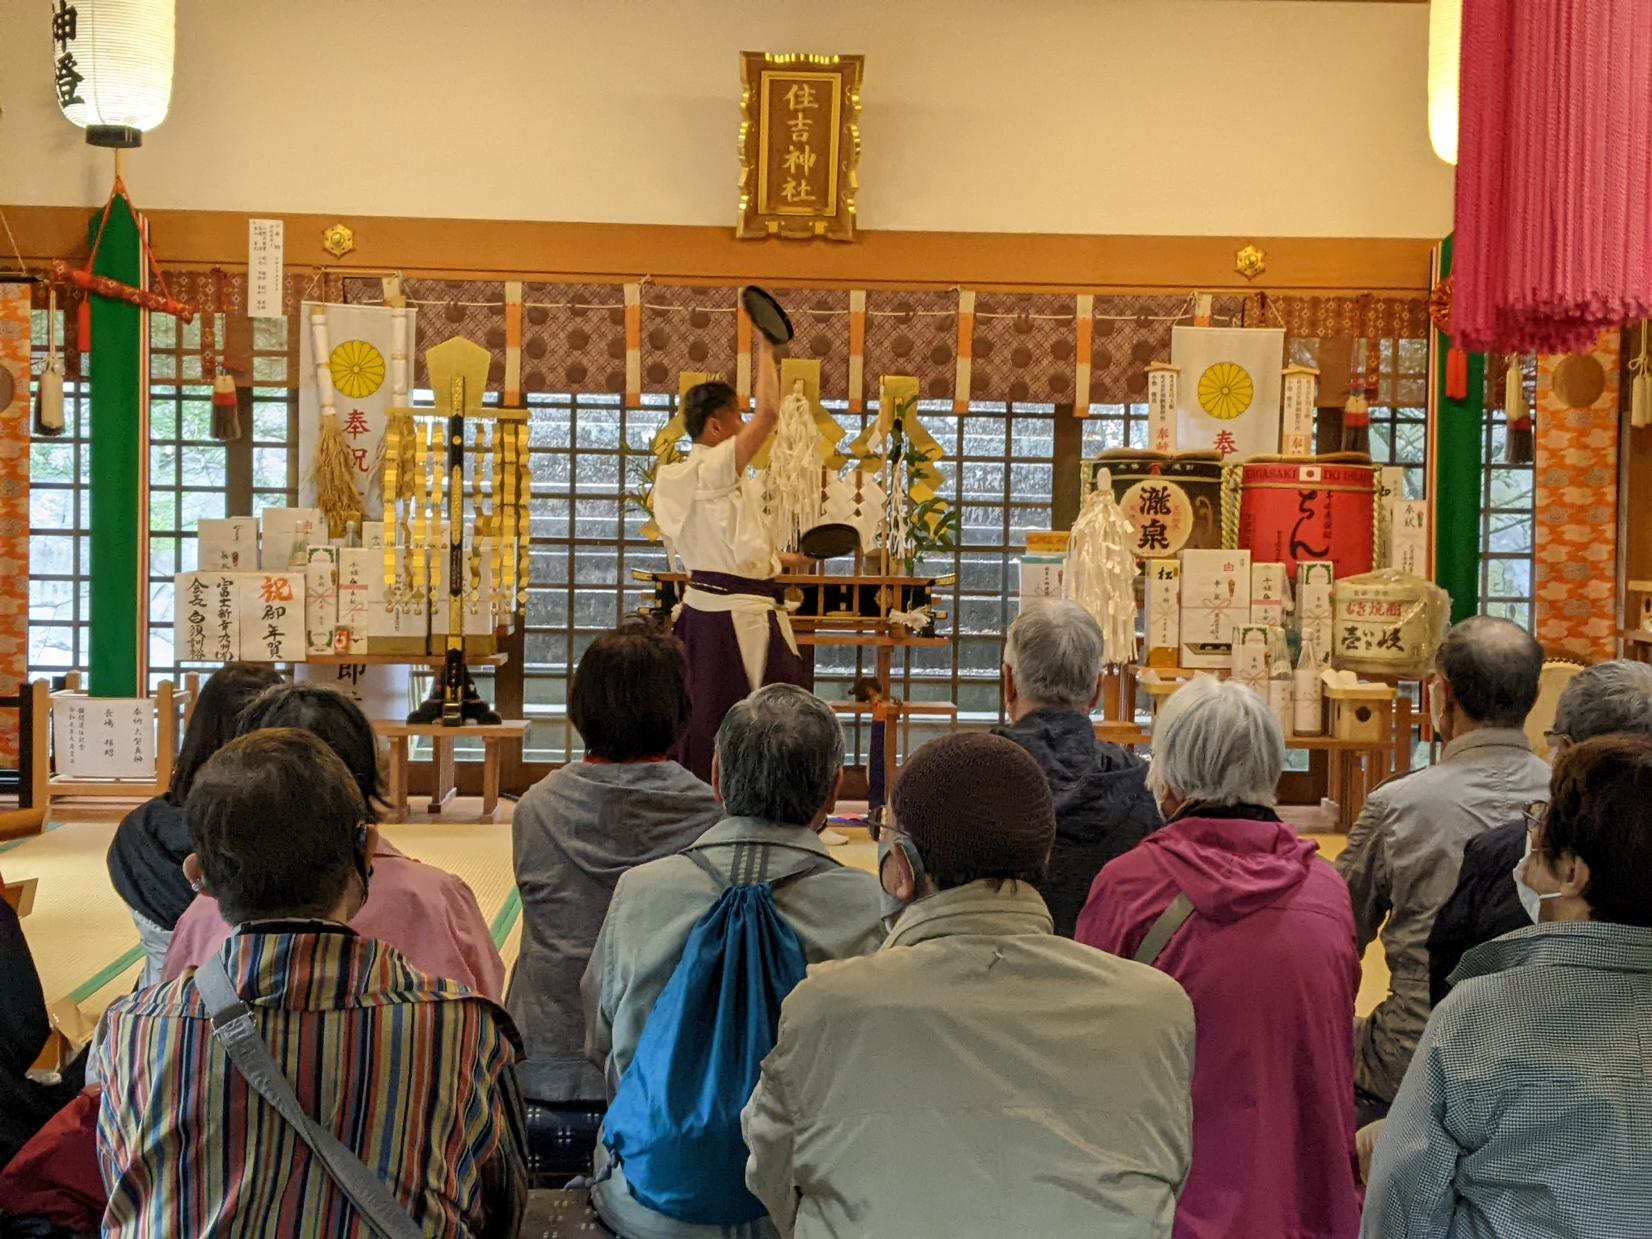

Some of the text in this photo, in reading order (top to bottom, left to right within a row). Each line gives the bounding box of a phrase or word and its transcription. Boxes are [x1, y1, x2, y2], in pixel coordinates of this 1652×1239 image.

[782, 83, 818, 202] 住吉神社
[1213, 430, 1239, 459] 奉
[258, 576, 293, 603] 祝
[261, 605, 287, 659] 御年賀
